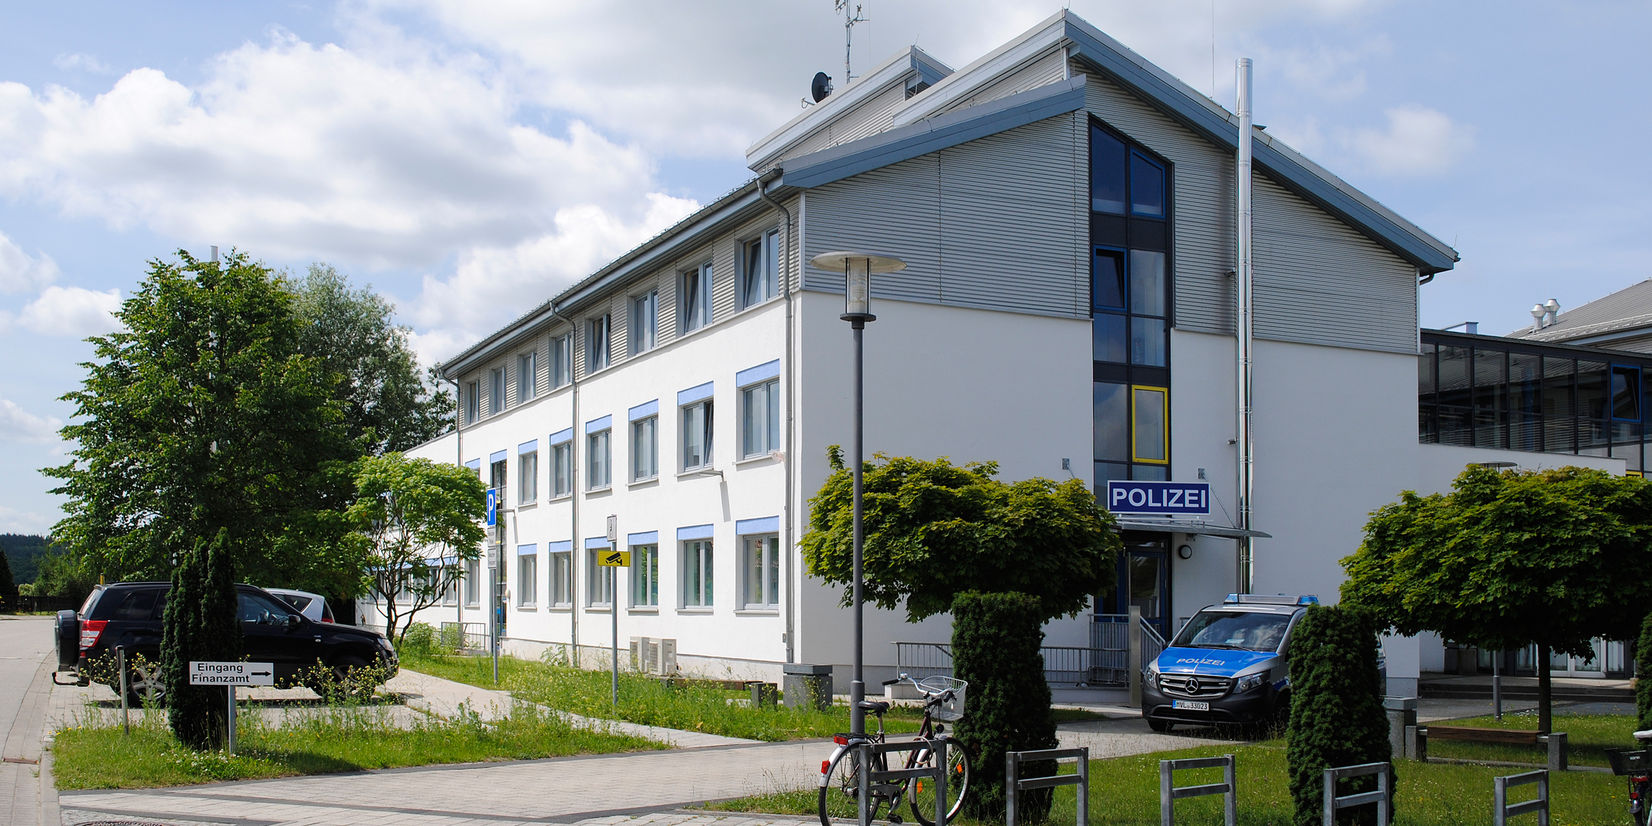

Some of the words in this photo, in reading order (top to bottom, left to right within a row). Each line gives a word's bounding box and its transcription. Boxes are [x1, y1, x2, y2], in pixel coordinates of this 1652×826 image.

[1112, 488, 1206, 508] POLIZEI
[488, 493, 494, 522] P
[1176, 658, 1225, 666] POLIZEI
[197, 663, 244, 673] Eingang
[192, 673, 250, 683] Finanzamt
